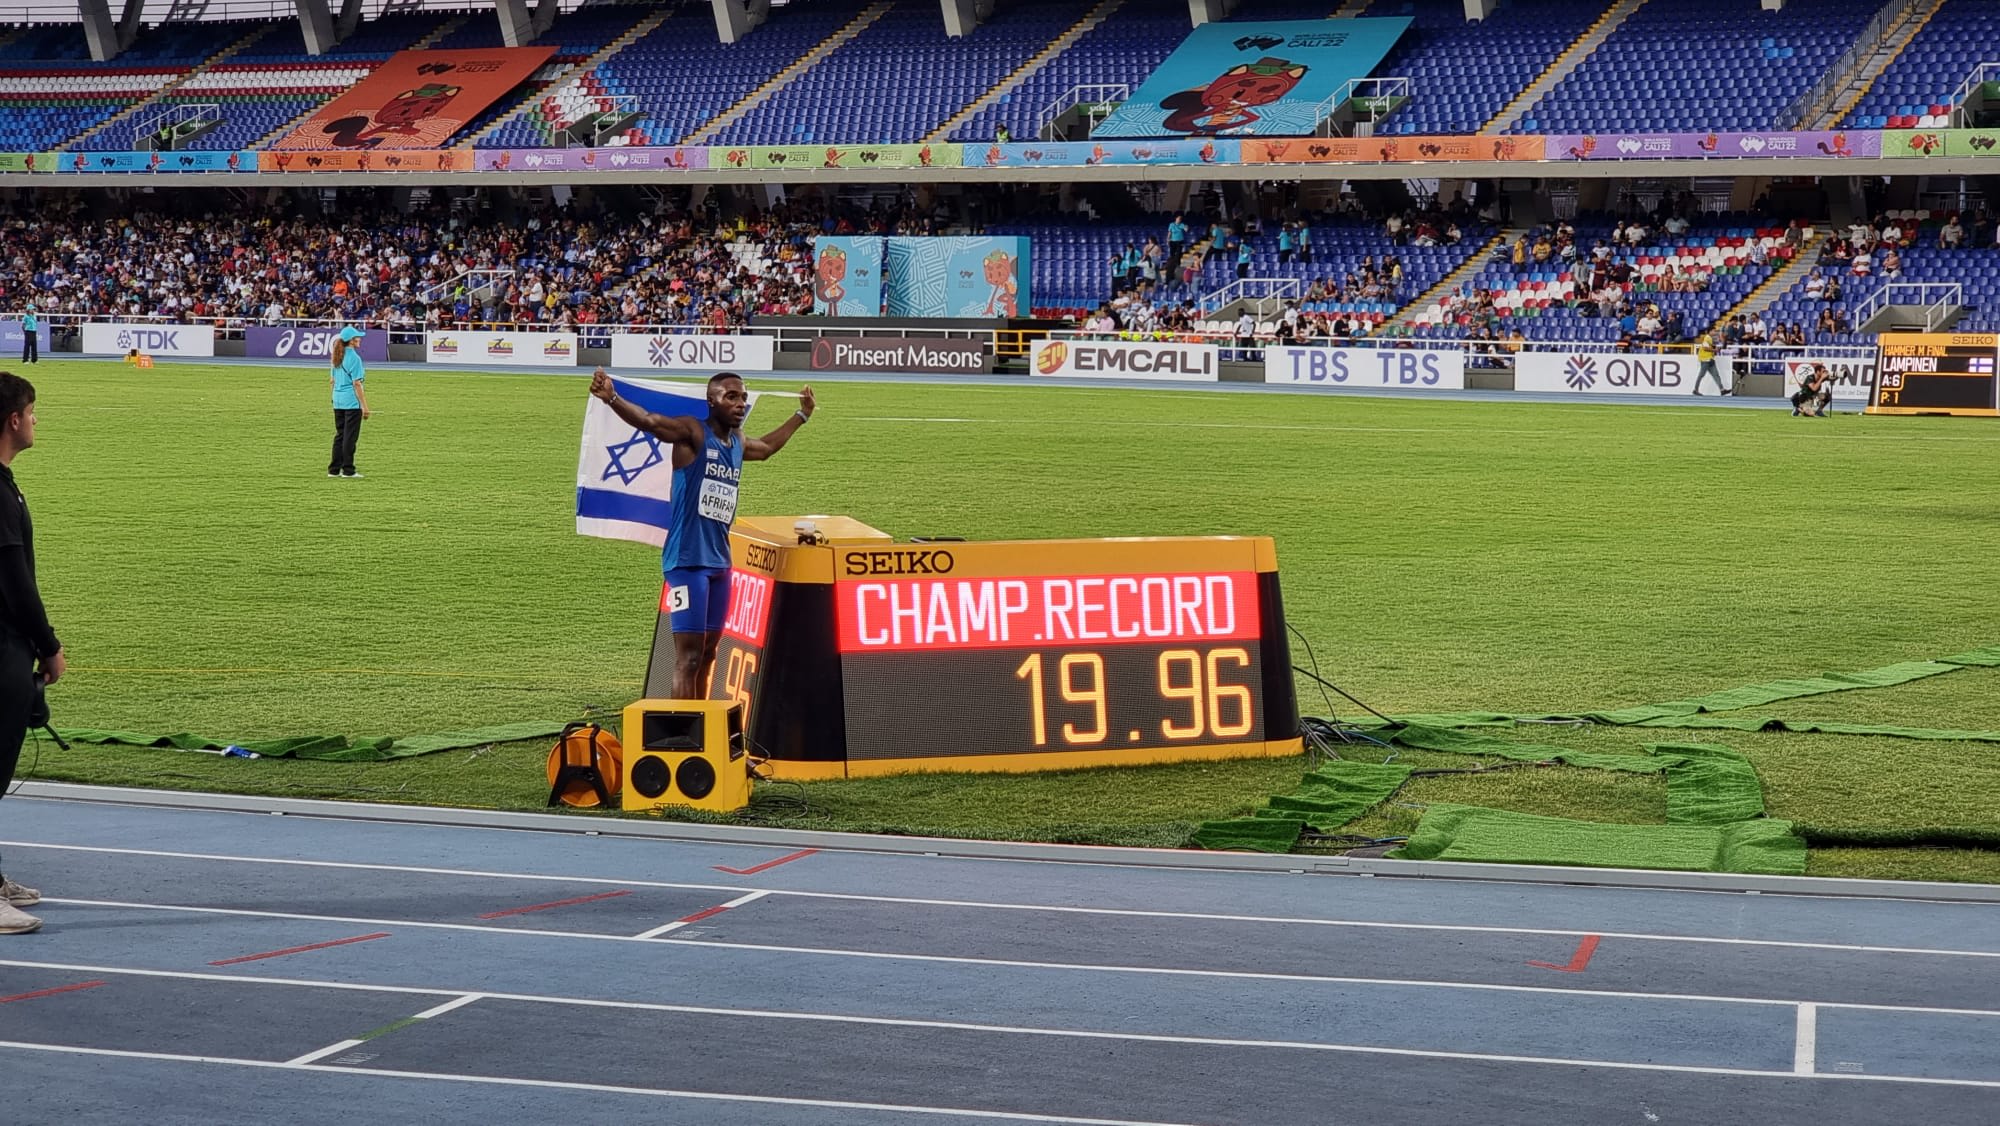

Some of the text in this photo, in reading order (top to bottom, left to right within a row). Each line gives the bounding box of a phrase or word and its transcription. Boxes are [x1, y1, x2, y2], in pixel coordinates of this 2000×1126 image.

[1287, 38, 1345, 48] CALI 22
[1644, 143, 1672, 151] CALI 22
[1768, 142, 1796, 150] CALI 22
[132, 330, 179, 350] TDK
[300, 332, 338, 356] asic
[1952, 336, 1994, 345] SEIKO
[679, 339, 736, 364] QNB
[835, 344, 983, 368] Pinsent Masons
[1884, 345, 1948, 356] HAMMER M FINAL
[1075, 348, 1211, 375] EMCALI
[1287, 349, 1440, 385] TBS TBS
[1883, 357, 1937, 372] LAMPINEN
[1605, 359, 1682, 387] QNB
[1881, 374, 1901, 387] A:6
[717, 484, 735, 497] TDK
[701, 494, 735, 512] AFRIFAH
[712, 511, 723, 519] CALI
[746, 543, 777, 572] SEIKO
[845, 550, 954, 575] SEIKO
[674, 590, 682, 607] 5
[1016, 647, 1252, 745] 19.96
